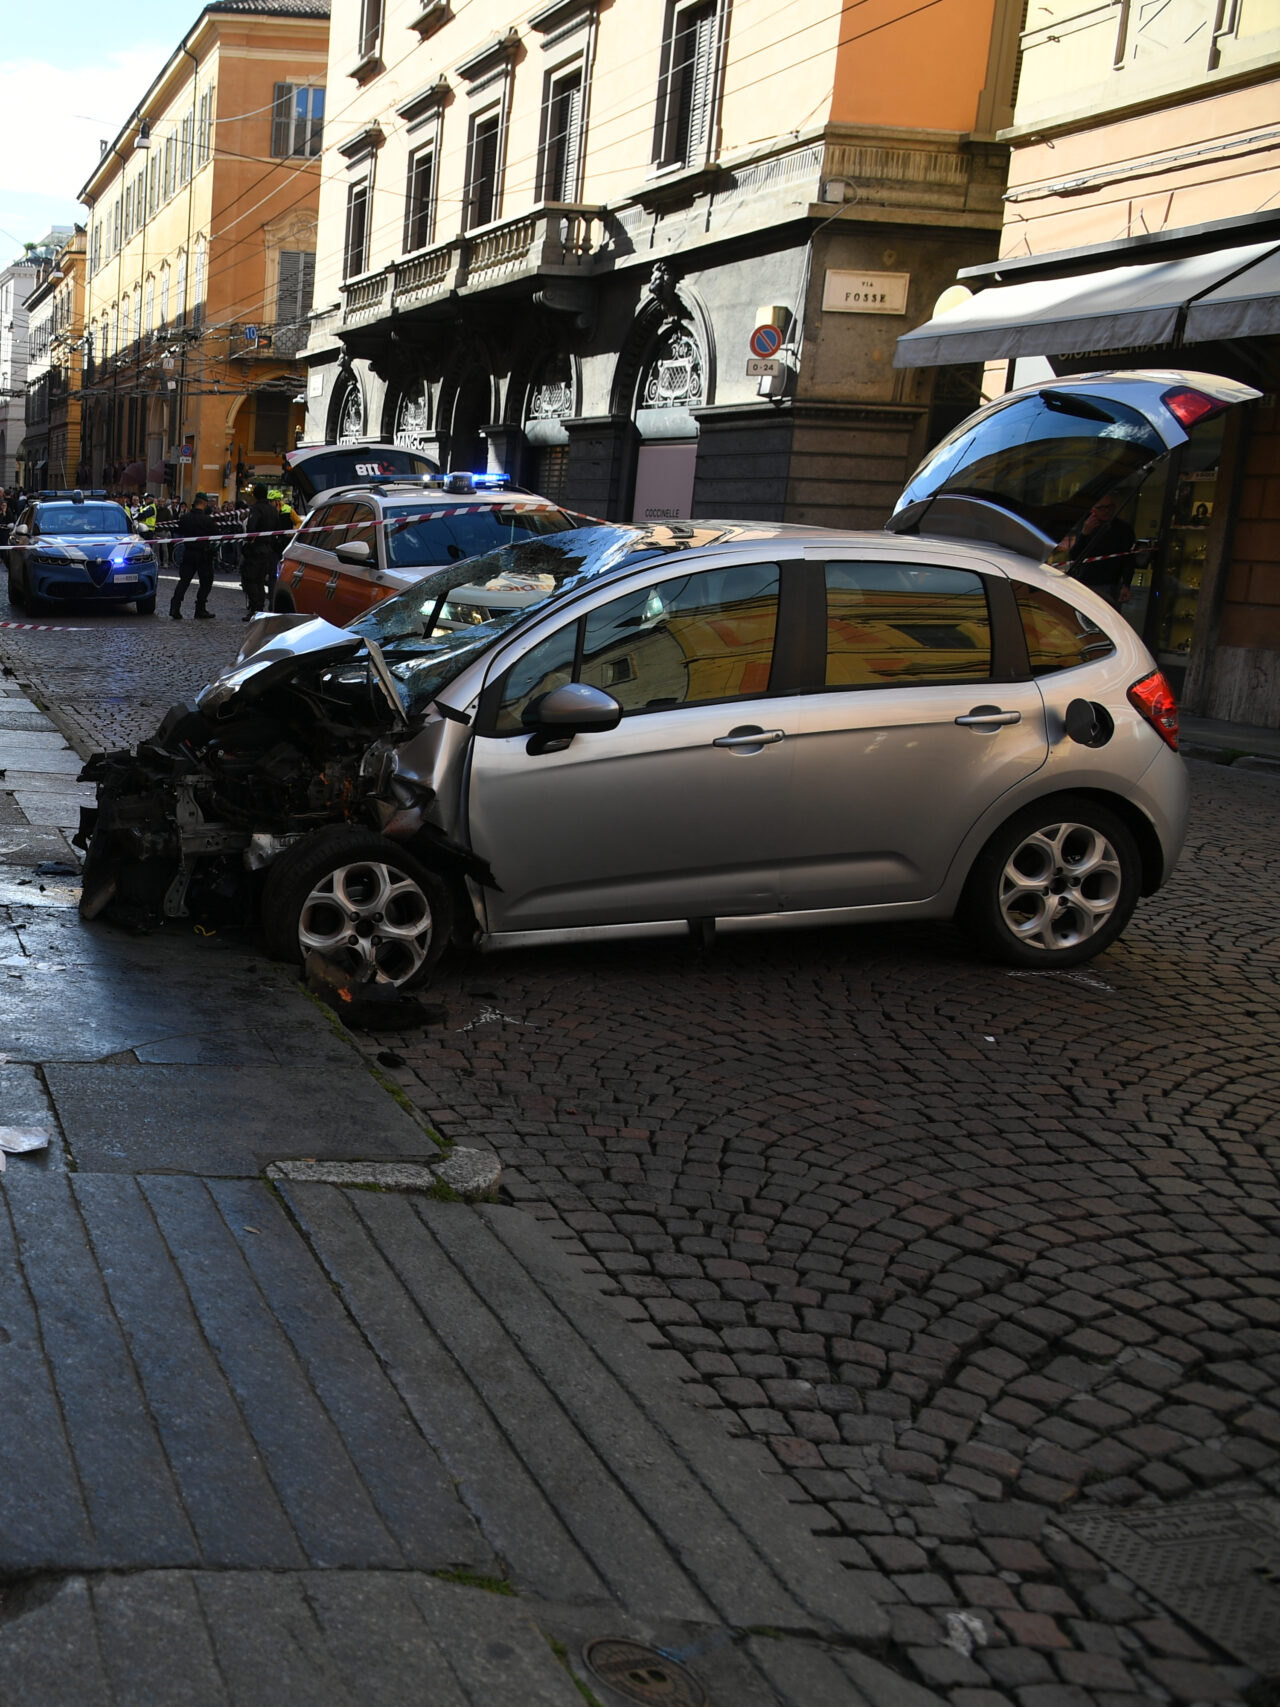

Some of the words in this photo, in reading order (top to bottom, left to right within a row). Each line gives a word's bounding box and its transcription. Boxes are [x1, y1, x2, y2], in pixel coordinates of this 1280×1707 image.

[844, 292, 887, 303] FOSSE
[245, 327, 257, 339] 10
[645, 508, 680, 518] COCCINELLE
